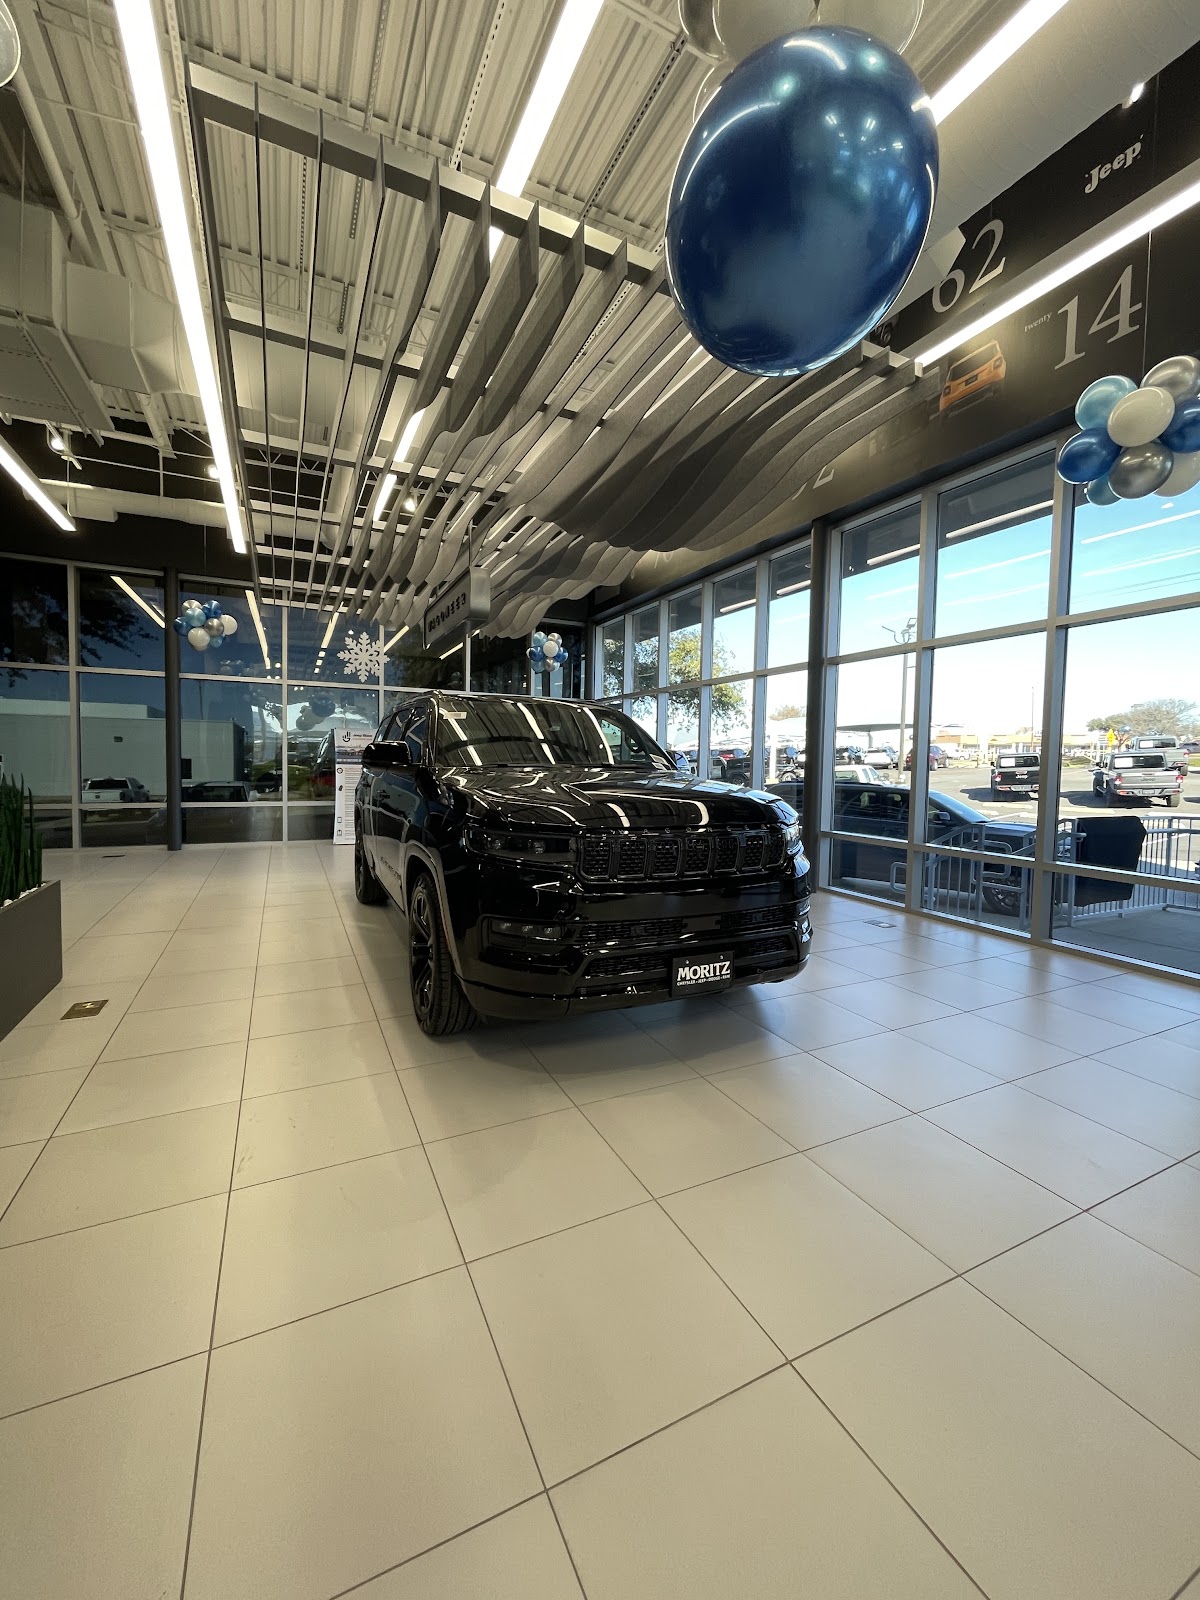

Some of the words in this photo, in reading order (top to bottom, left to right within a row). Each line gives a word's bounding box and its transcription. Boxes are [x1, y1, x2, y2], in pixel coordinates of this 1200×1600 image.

[1083, 139, 1143, 194] Jeep
[931, 218, 1007, 314] 62
[1024, 311, 1053, 333] twenty
[1054, 264, 1143, 370] 14
[677, 961, 731, 981] MORITZ
